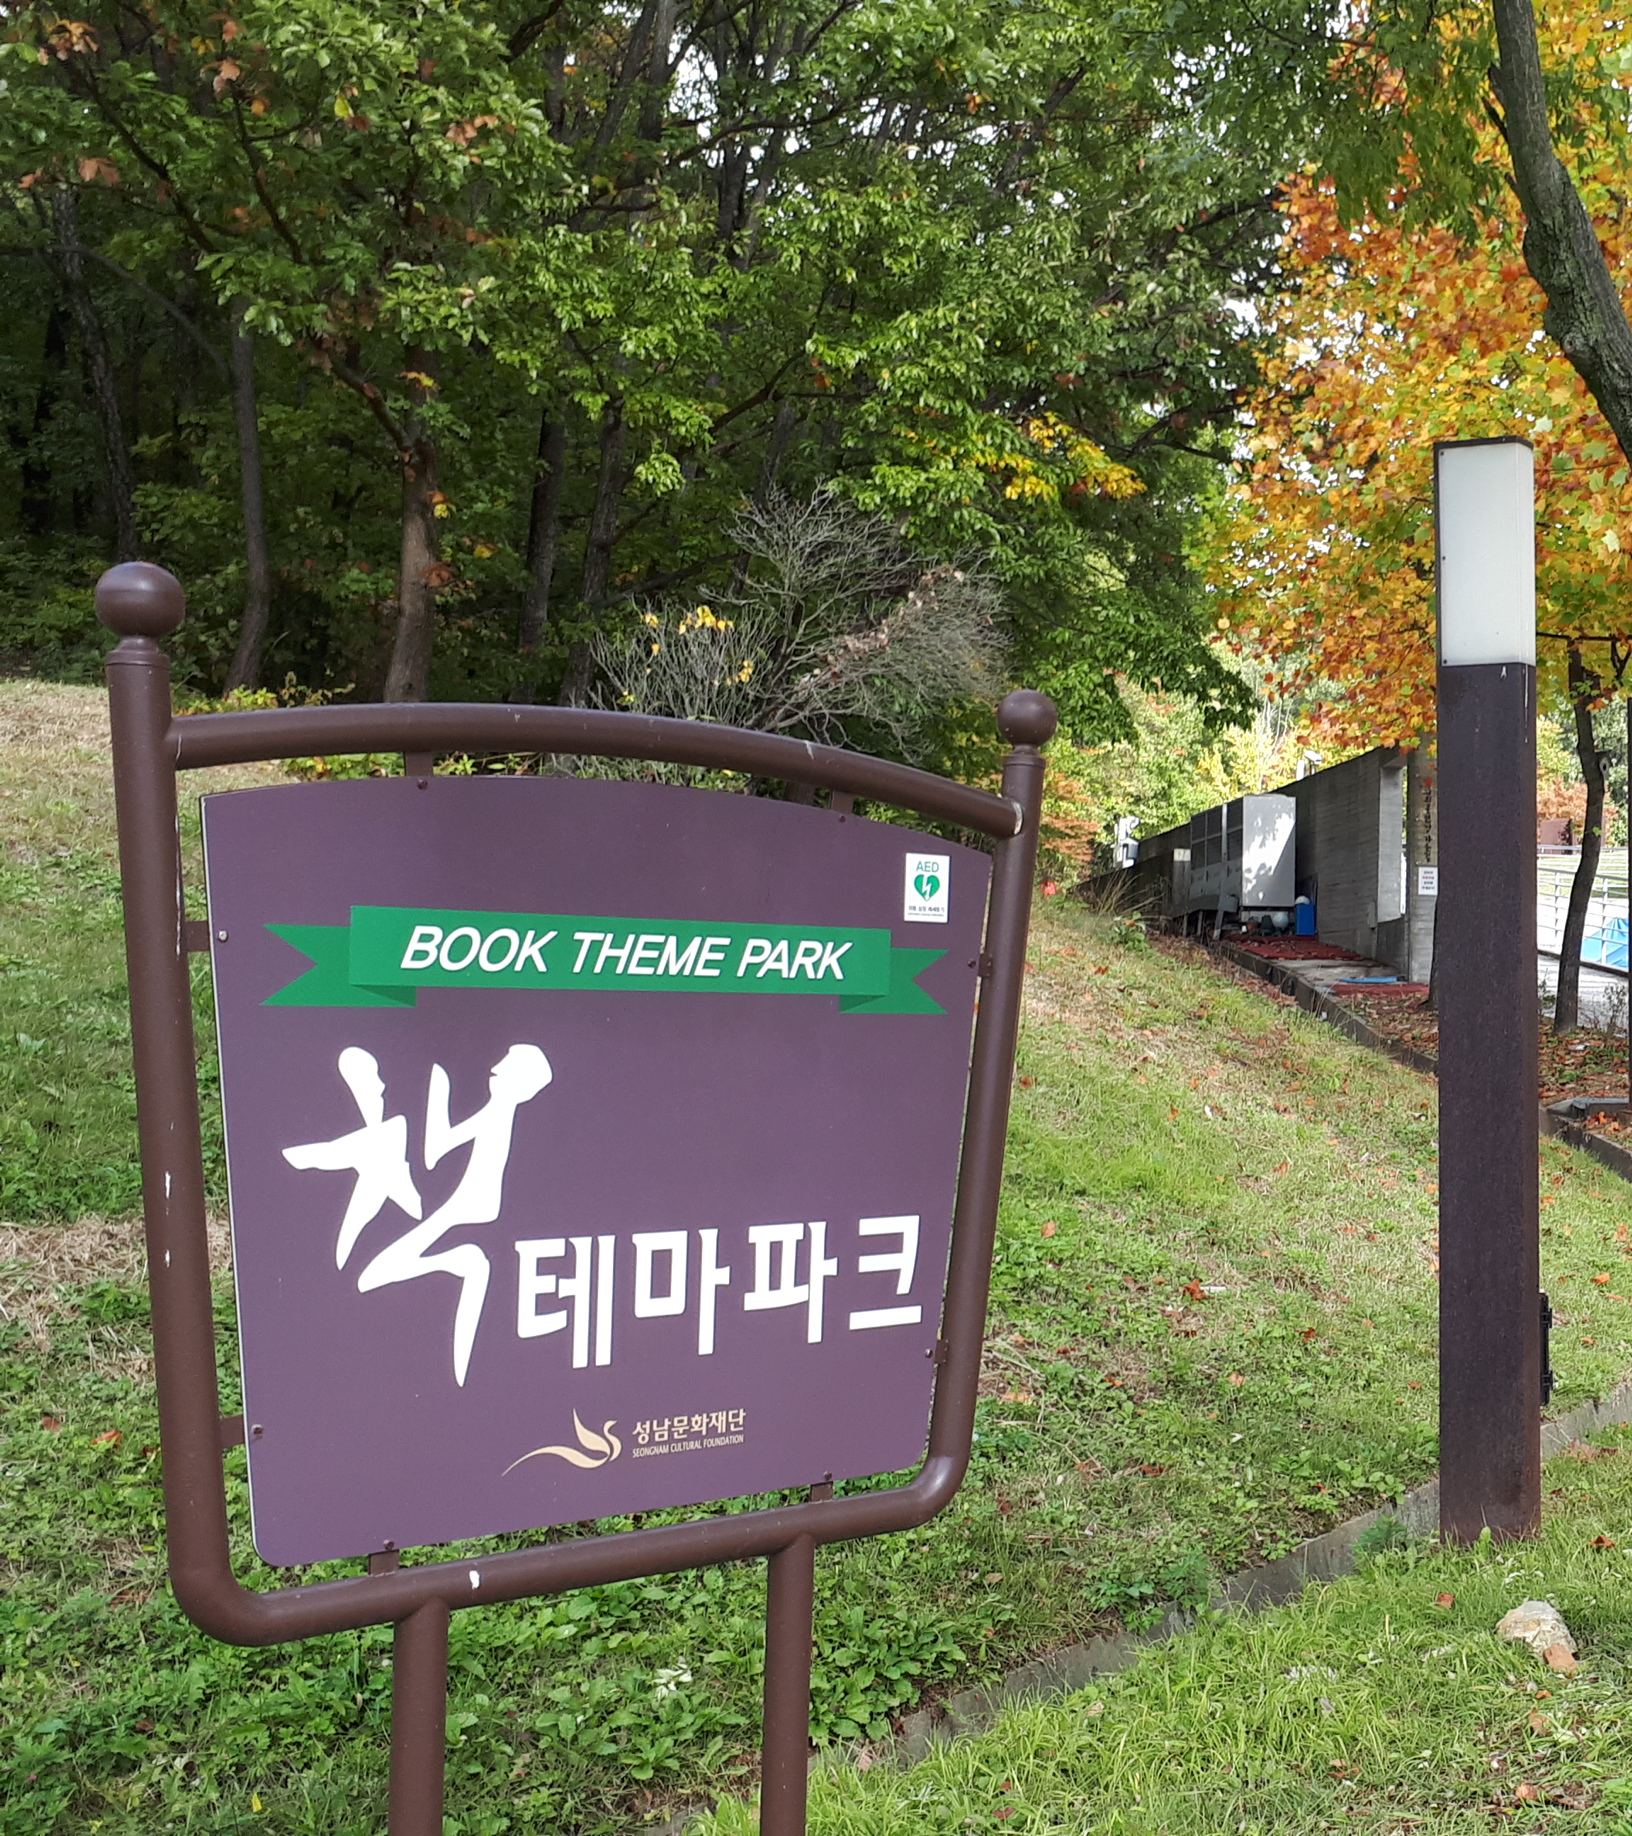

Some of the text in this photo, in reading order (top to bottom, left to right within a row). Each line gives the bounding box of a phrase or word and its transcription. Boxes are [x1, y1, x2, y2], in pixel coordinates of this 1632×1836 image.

[915, 860, 940, 873] AED
[400, 925, 853, 980] BOOK THEME PARK
[281, 1043, 922, 1388] 책 테마파크
[632, 1408, 747, 1445] 성남문화재단
[632, 1434, 744, 1459] SEONGNAM CULTURAL FOUNDATION
